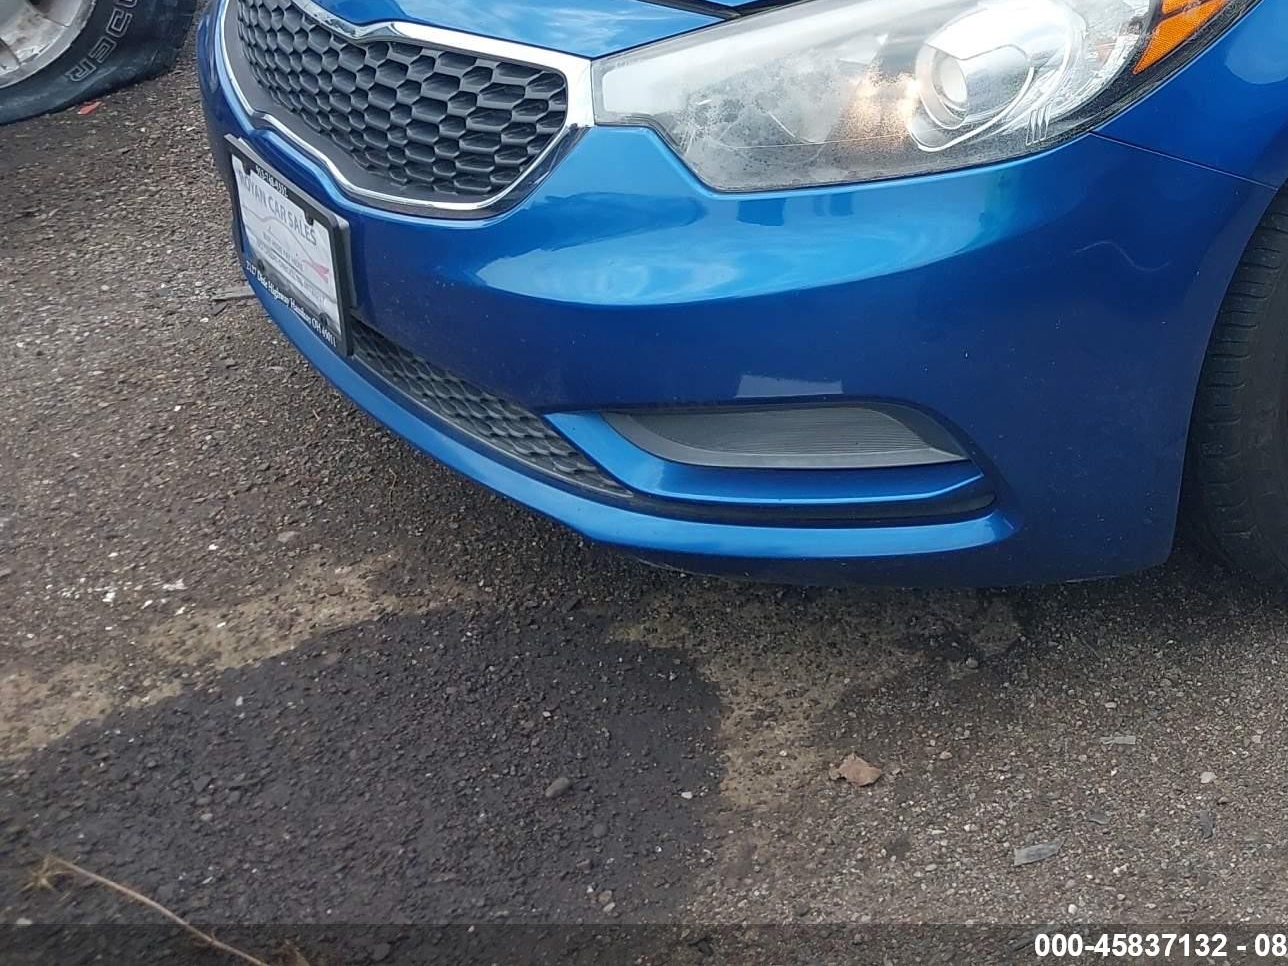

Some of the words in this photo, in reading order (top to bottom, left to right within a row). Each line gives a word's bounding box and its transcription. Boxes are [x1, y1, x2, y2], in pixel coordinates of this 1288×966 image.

[268, 195, 288, 225] CAR
[287, 210, 318, 247] SALES
[311, 317, 322, 334] OH
